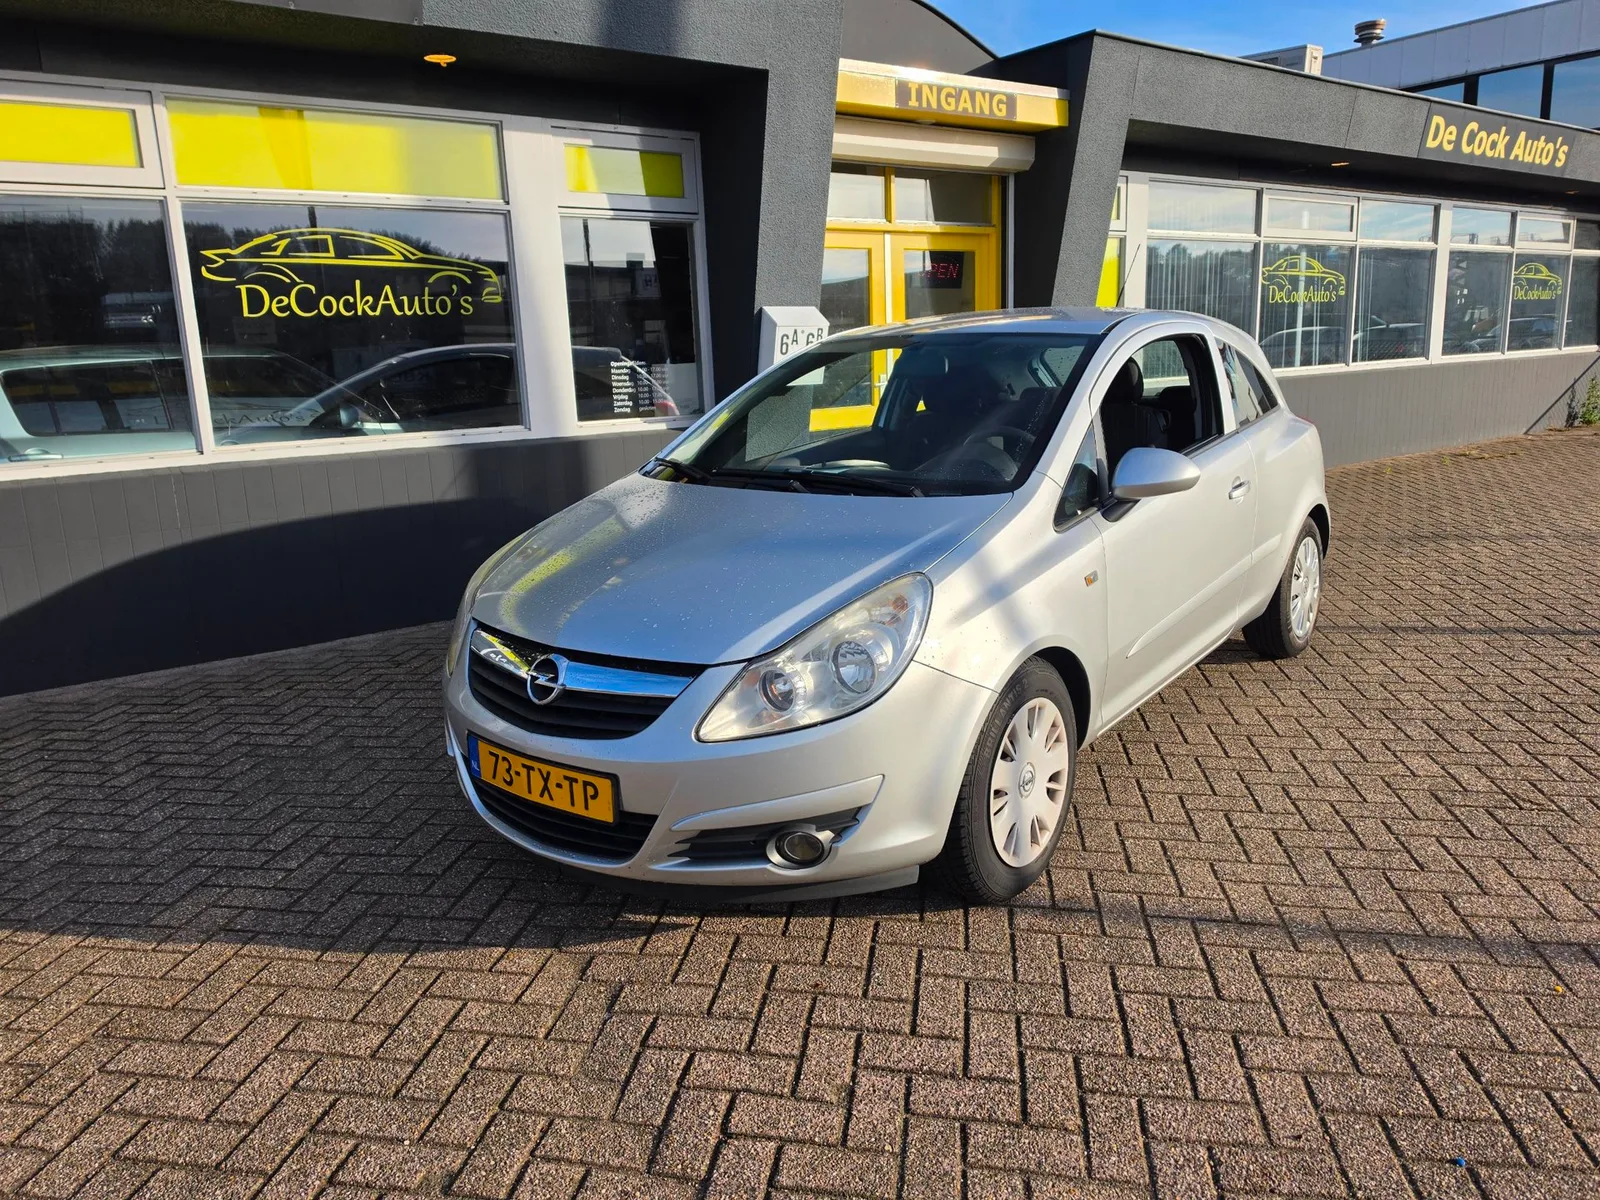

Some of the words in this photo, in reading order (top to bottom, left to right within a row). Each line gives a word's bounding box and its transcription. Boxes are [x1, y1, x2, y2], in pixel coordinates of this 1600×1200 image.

[908, 82, 1007, 117] INGANG
[1426, 115, 1457, 151] De
[1461, 121, 1511, 159] Cock
[1509, 130, 1569, 168] Auto's
[235, 279, 474, 318] DeCockAuto's
[488, 750, 599, 811] 73-TX-TP
